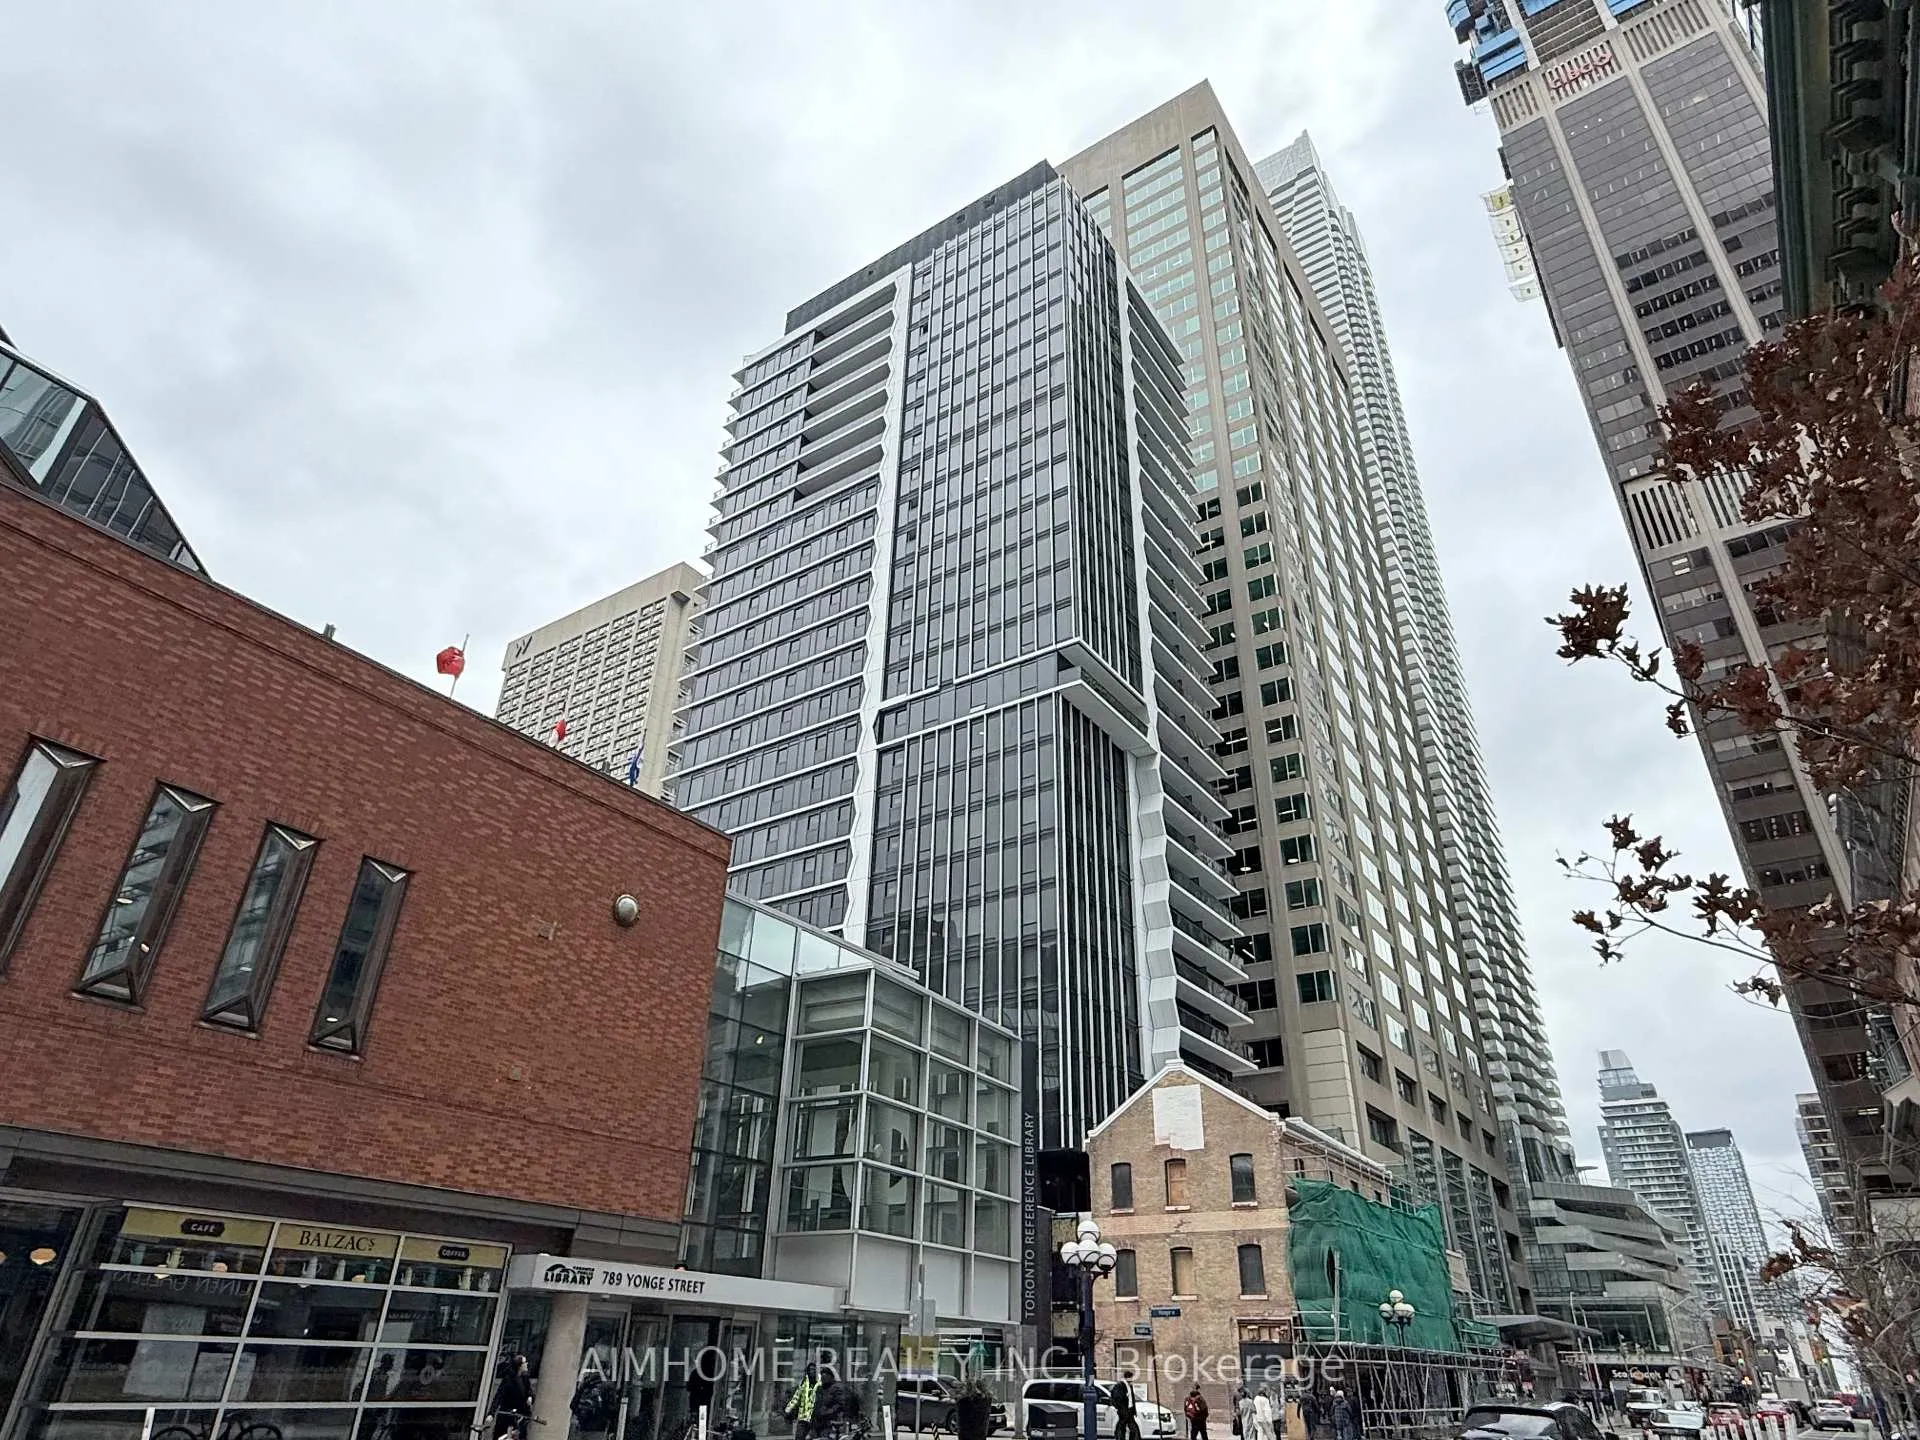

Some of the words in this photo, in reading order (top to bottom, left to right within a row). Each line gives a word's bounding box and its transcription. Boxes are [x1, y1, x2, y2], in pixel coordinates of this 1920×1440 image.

[1024, 1112, 1035, 1166] LIBRARY
[1024, 1168, 1035, 1245] REFERENCE
[543, 1271, 594, 1285] LIBRARY
[602, 1271, 622, 1286] 789
[626, 1273, 665, 1290] YONGE
[668, 1278, 706, 1294] STREET
[1024, 1249, 1036, 1319] TORONTO
